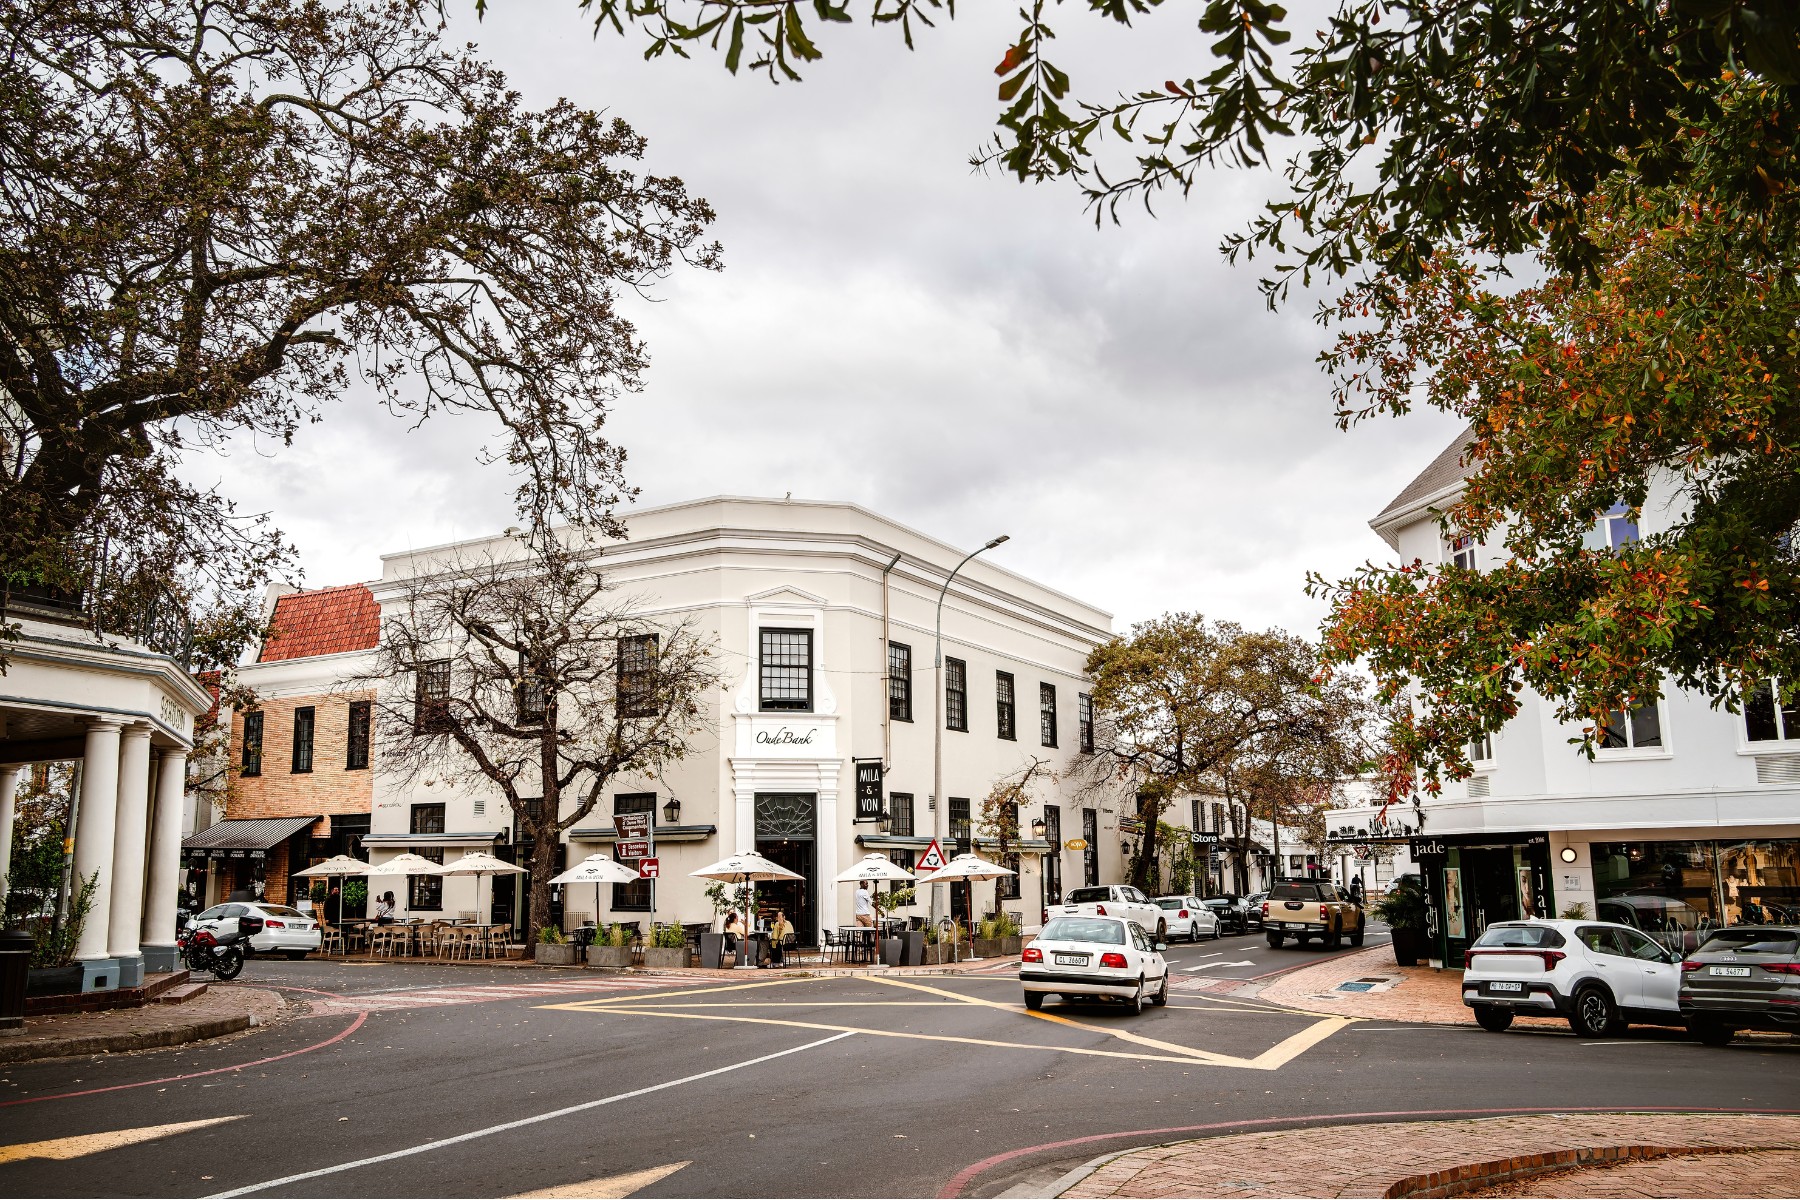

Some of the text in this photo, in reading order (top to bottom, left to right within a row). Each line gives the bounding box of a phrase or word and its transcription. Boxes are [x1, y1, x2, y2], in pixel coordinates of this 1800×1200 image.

[860, 769, 879, 782] MILA
[861, 798, 878, 812] VON
[1191, 833, 1218, 843] iStore
[1413, 840, 1445, 857] jade
